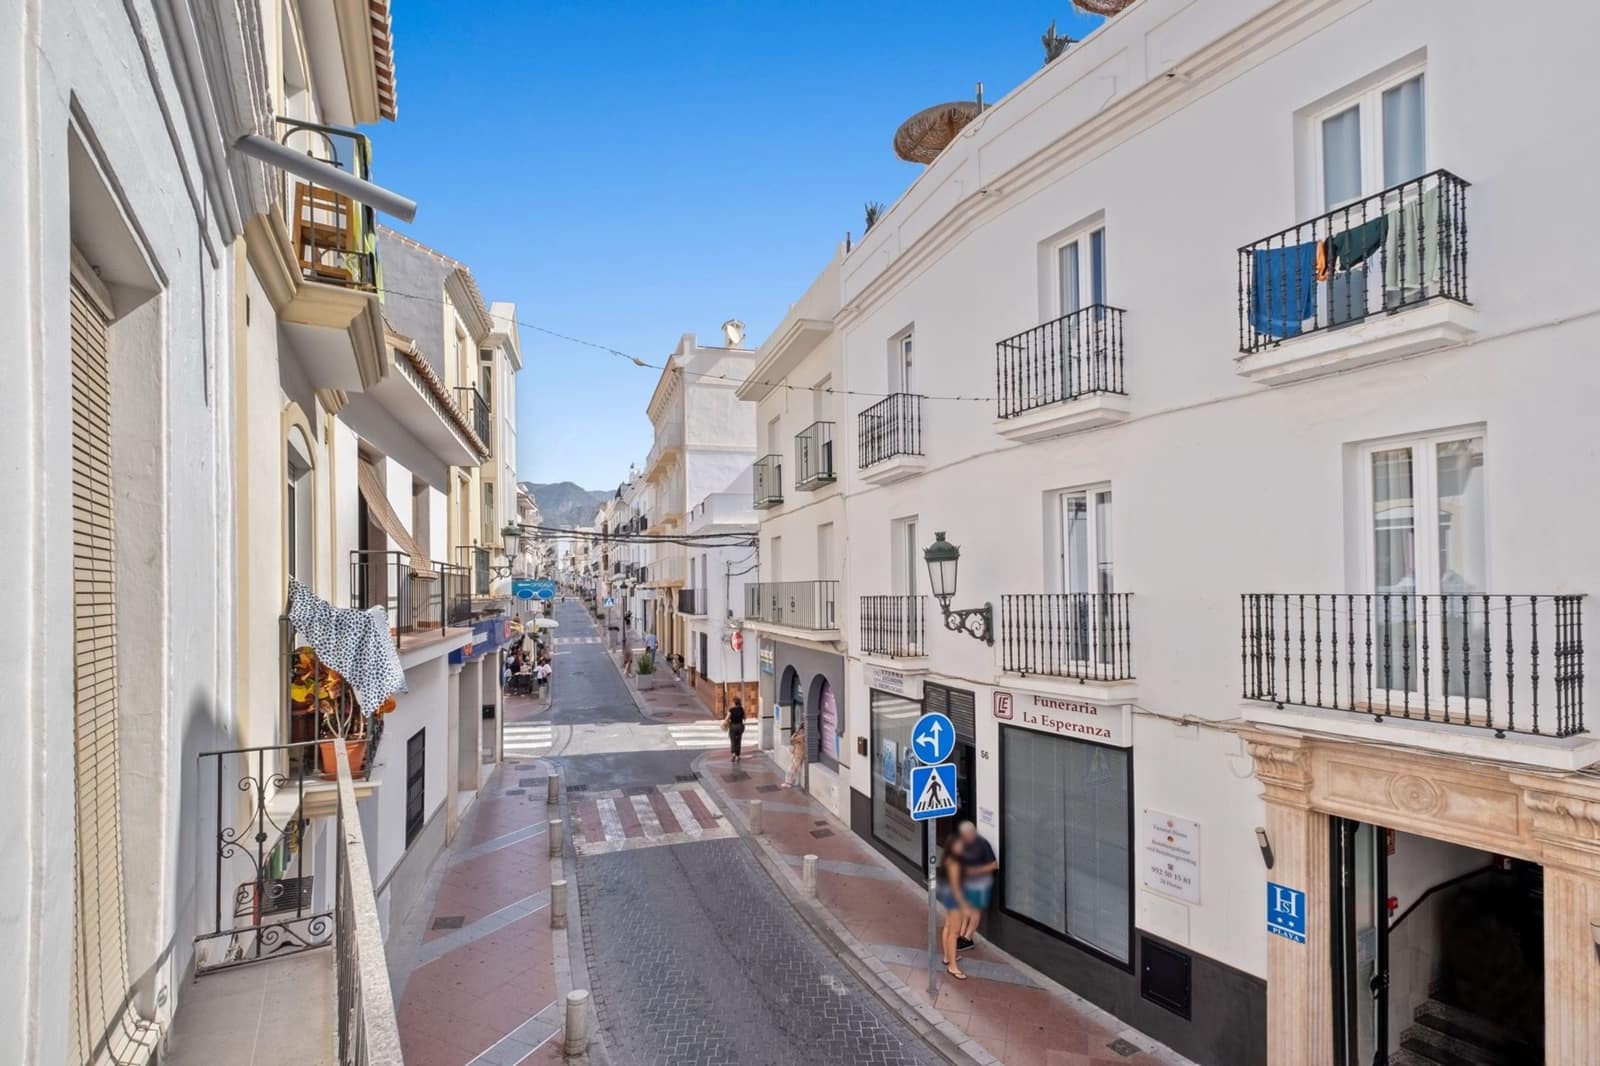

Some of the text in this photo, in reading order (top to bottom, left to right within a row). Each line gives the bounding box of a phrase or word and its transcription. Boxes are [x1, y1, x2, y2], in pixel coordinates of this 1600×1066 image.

[1033, 695, 1097, 715] Funeraria
[1023, 711, 1111, 738] La Esperanza
[1273, 927, 1300, 942] PLAYA
